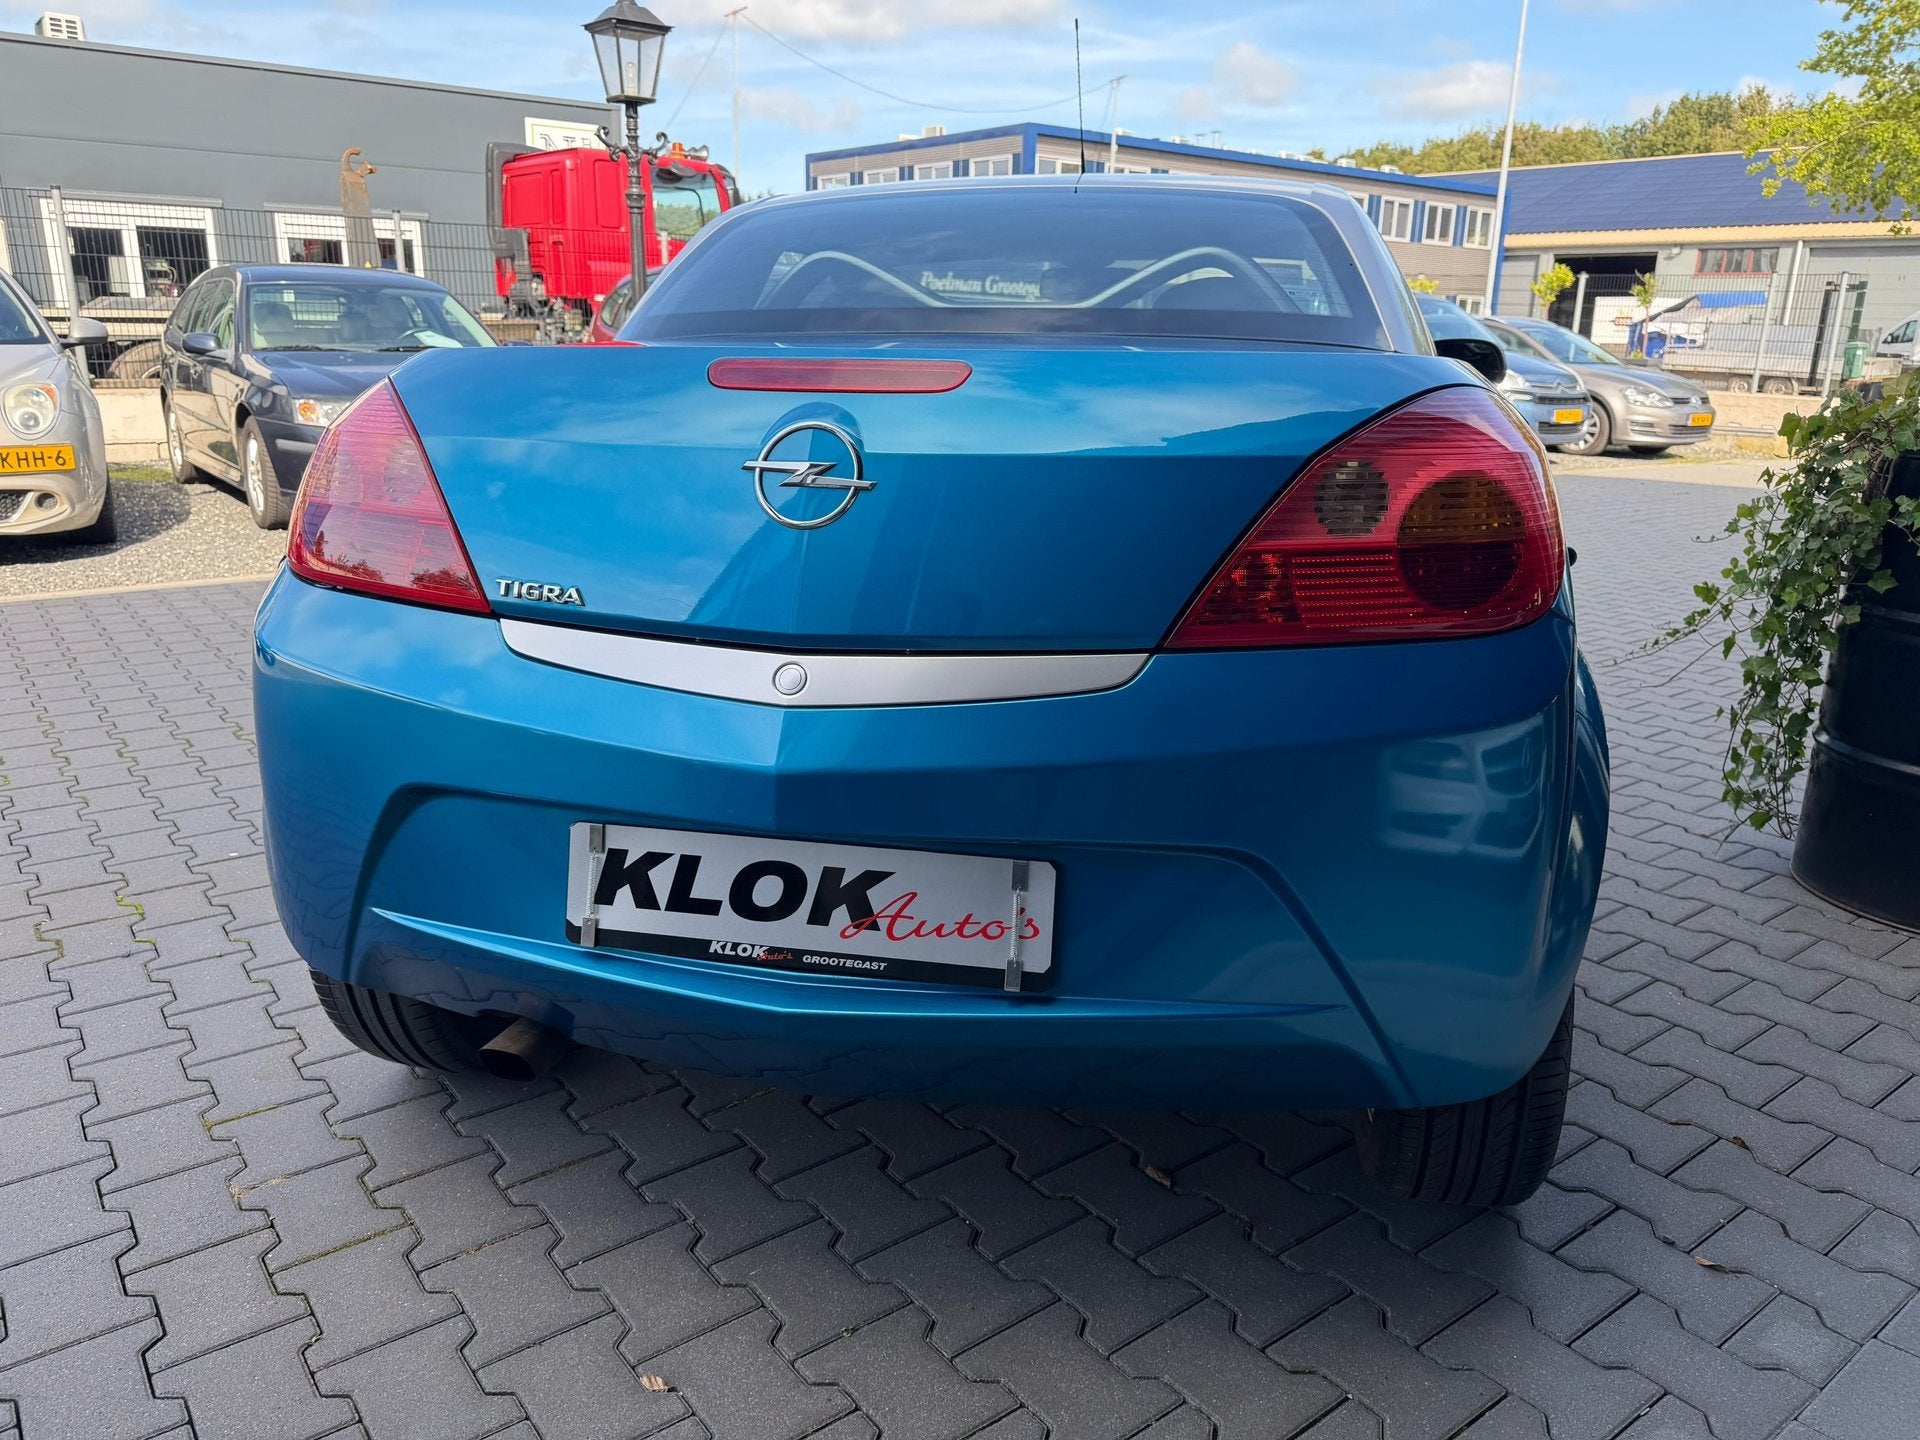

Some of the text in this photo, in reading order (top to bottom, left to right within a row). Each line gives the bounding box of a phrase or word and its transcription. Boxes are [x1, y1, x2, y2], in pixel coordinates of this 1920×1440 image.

[0, 450, 67, 469] KHH-6
[496, 578, 585, 606] TIGRA
[594, 847, 1040, 941] KLOK Auto's
[709, 940, 888, 971] KLOK Auto's GROOTEGAST
